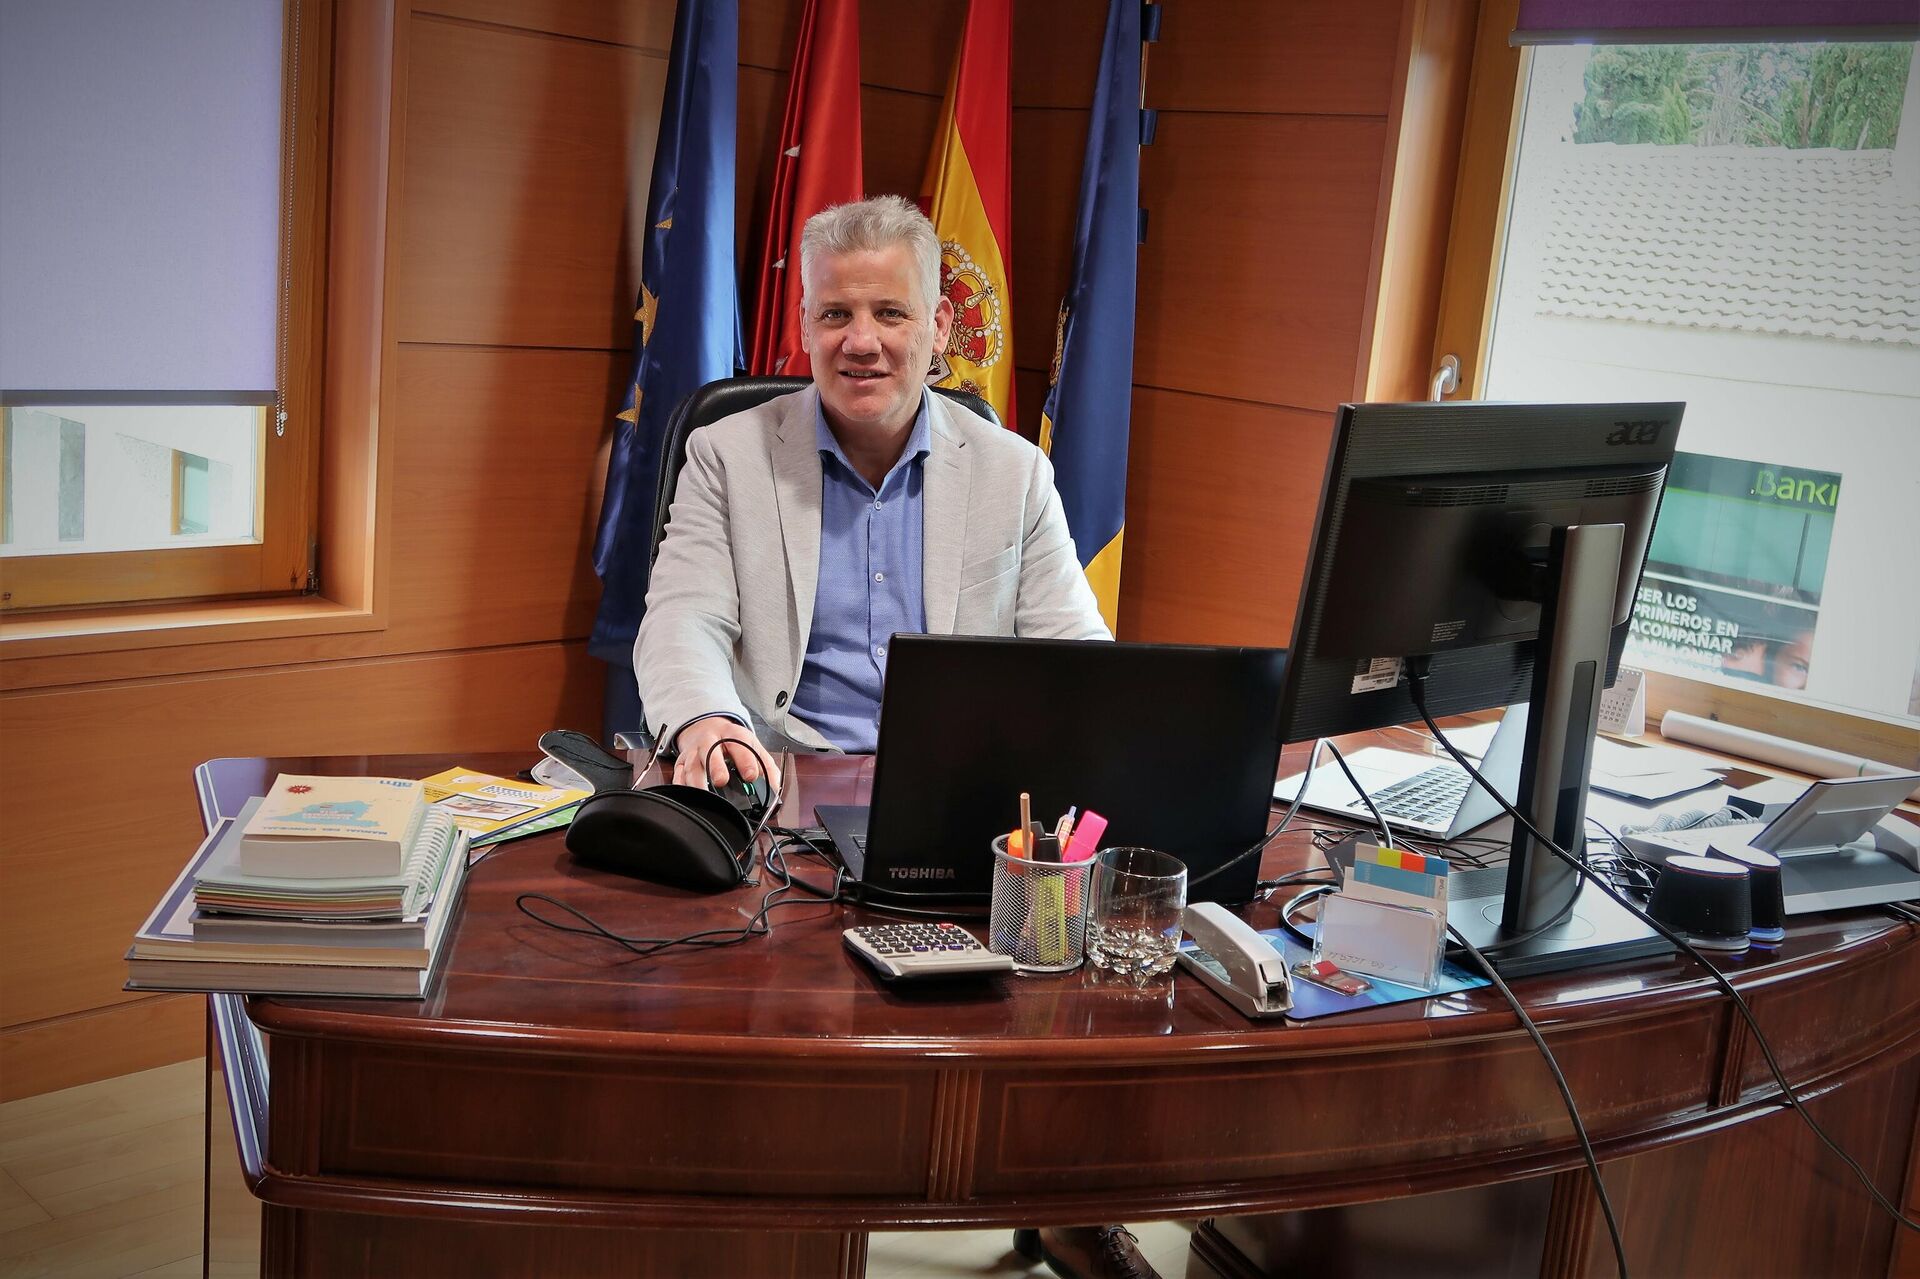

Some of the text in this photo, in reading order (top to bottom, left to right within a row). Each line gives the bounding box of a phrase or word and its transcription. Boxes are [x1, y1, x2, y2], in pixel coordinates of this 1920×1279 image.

[1606, 420, 1670, 446] acer
[1666, 591, 1697, 612] LOS
[1633, 603, 1739, 639] PRIMEROS EN
[1629, 618, 1733, 654] ACOMPAÑAR
[888, 867, 955, 879] TOSHIBA
